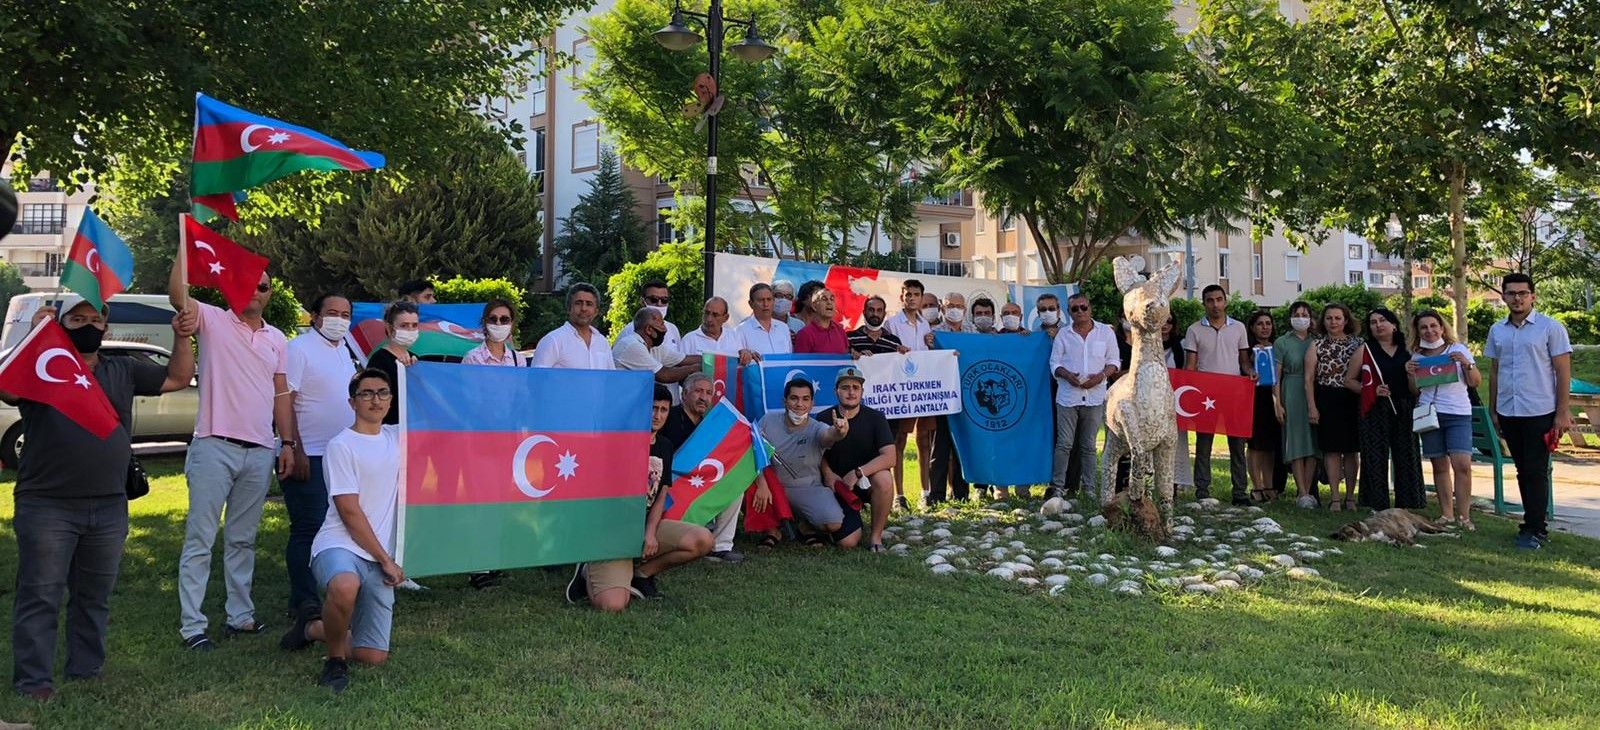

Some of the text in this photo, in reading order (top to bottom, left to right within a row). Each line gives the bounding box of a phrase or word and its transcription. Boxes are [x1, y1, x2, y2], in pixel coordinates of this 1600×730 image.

[963, 363, 1024, 390] TÜRK OCAKLARI
[872, 380, 942, 394] IRAK TÜRKMEN
[894, 394, 908, 403] VE
[912, 390, 958, 402] DAYANIŞMA
[876, 402, 948, 415] RNEĞİ ANTALYA
[985, 420, 1008, 428] 1912
